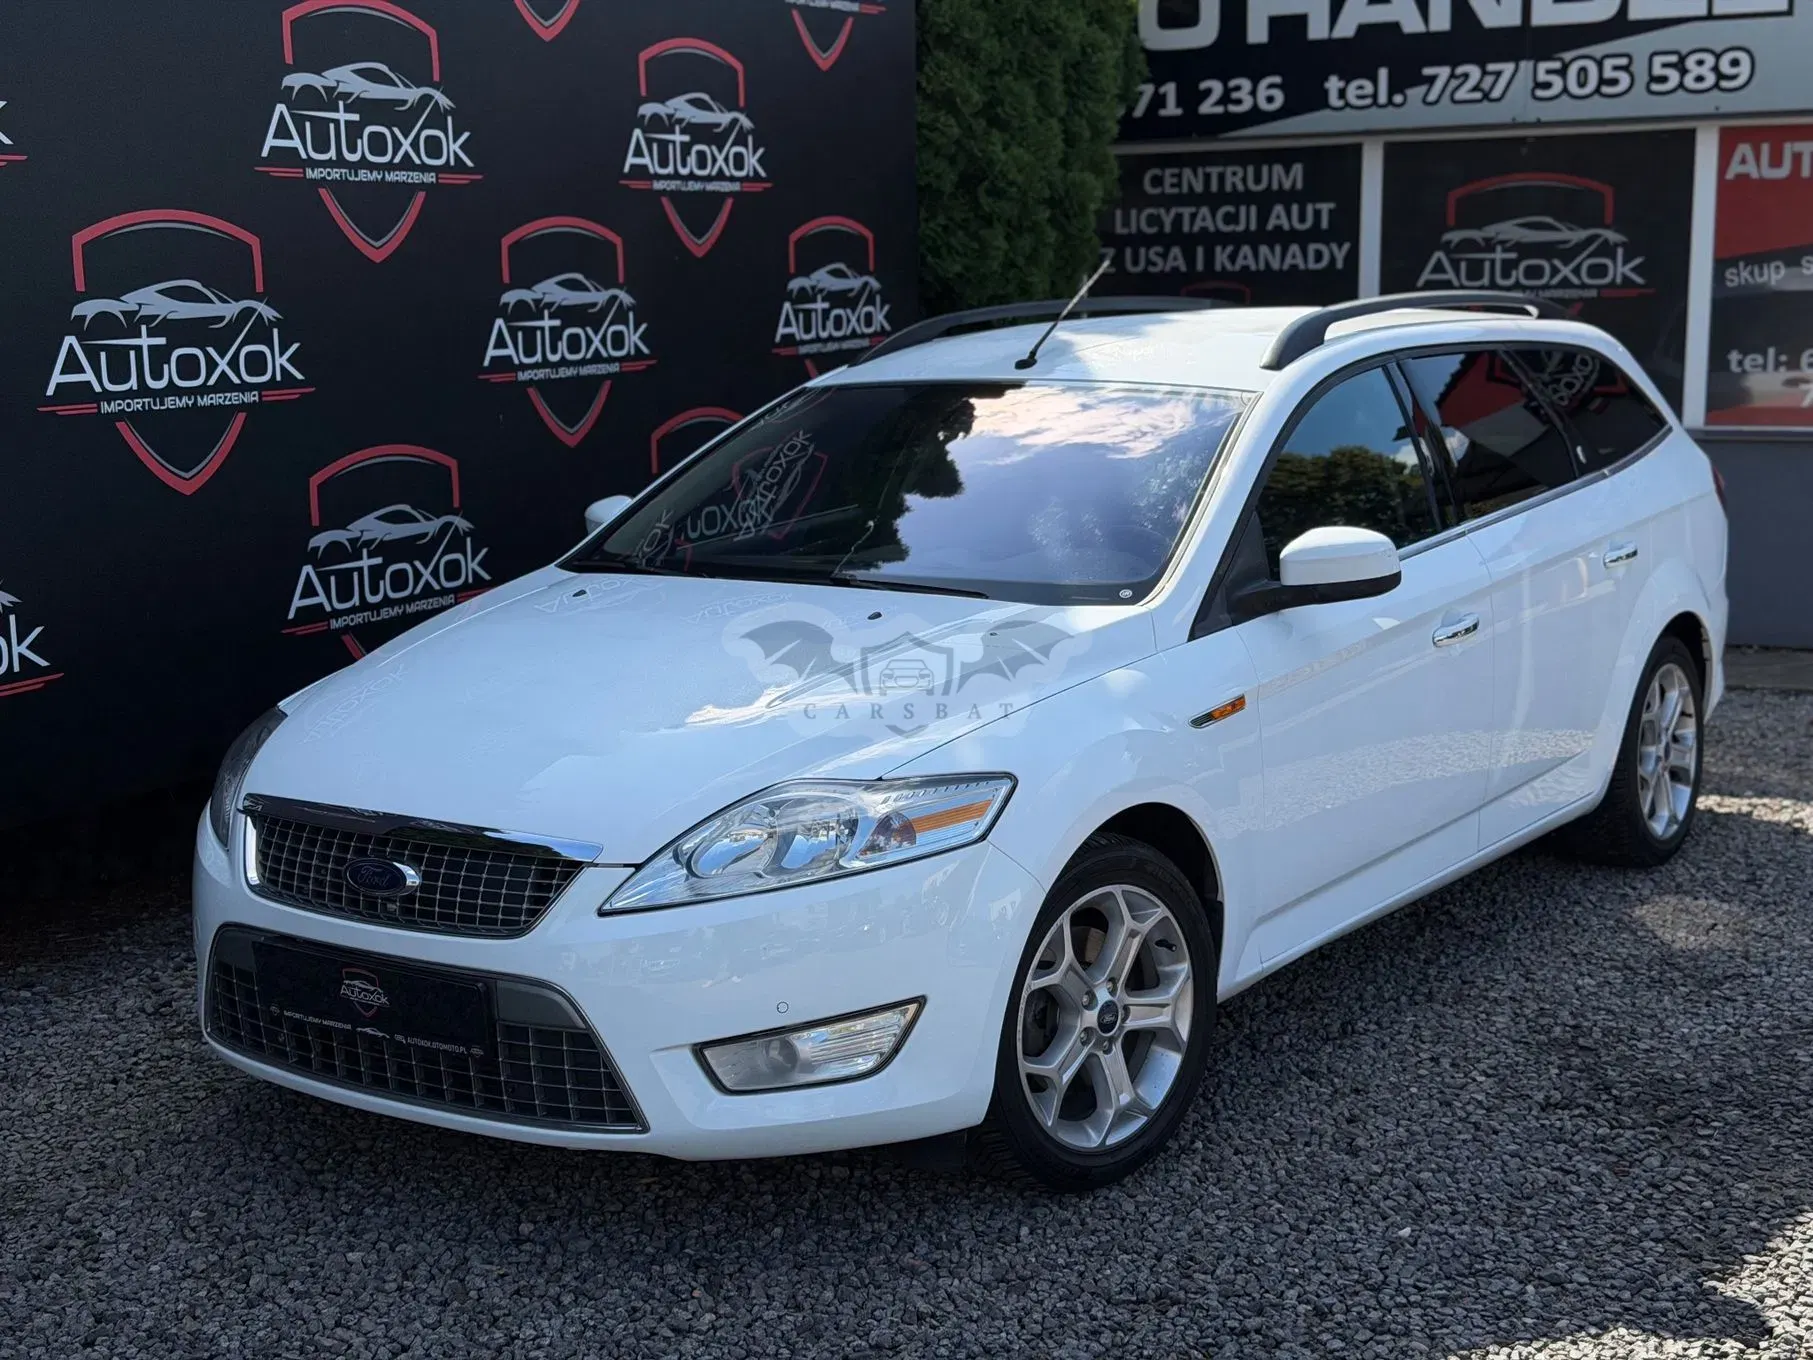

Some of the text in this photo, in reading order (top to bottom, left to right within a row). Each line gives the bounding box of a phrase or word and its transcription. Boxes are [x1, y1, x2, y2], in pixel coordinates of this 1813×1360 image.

[1197, 75, 1285, 116] 236
[1323, 66, 1408, 109] tel.
[1420, 61, 1520, 105] 727
[1532, 54, 1634, 100] 505
[1646, 47, 1755, 95] 589
[260, 97, 475, 168] Autoxok
[622, 124, 767, 178] Autoxok
[305, 168, 437, 185] IMPORTUJEMY MARZENIA
[1142, 162, 1305, 195] CENTRUM
[1114, 202, 1337, 235] LICYTACJI AUT
[1124, 246, 1188, 273] USA
[1196, 245, 1205, 272] I
[1214, 241, 1351, 273] KANADY
[1415, 244, 1647, 288] Autoxok
[1724, 260, 1786, 288] skup
[482, 308, 651, 368] Autoxok
[774, 292, 892, 344] Autoxok
[45, 322, 305, 397] Autoxok
[517, 362, 620, 383] IMPORTUJEMY MARZENIA
[1726, 346, 1788, 374] tel:
[100, 391, 260, 415] IMPORTUJEMY MARZENIA
[287, 534, 492, 620] Autoxok
[329, 593, 456, 631] IMPORTUJEMY MARZENIA
[0, 614, 51, 676] k
